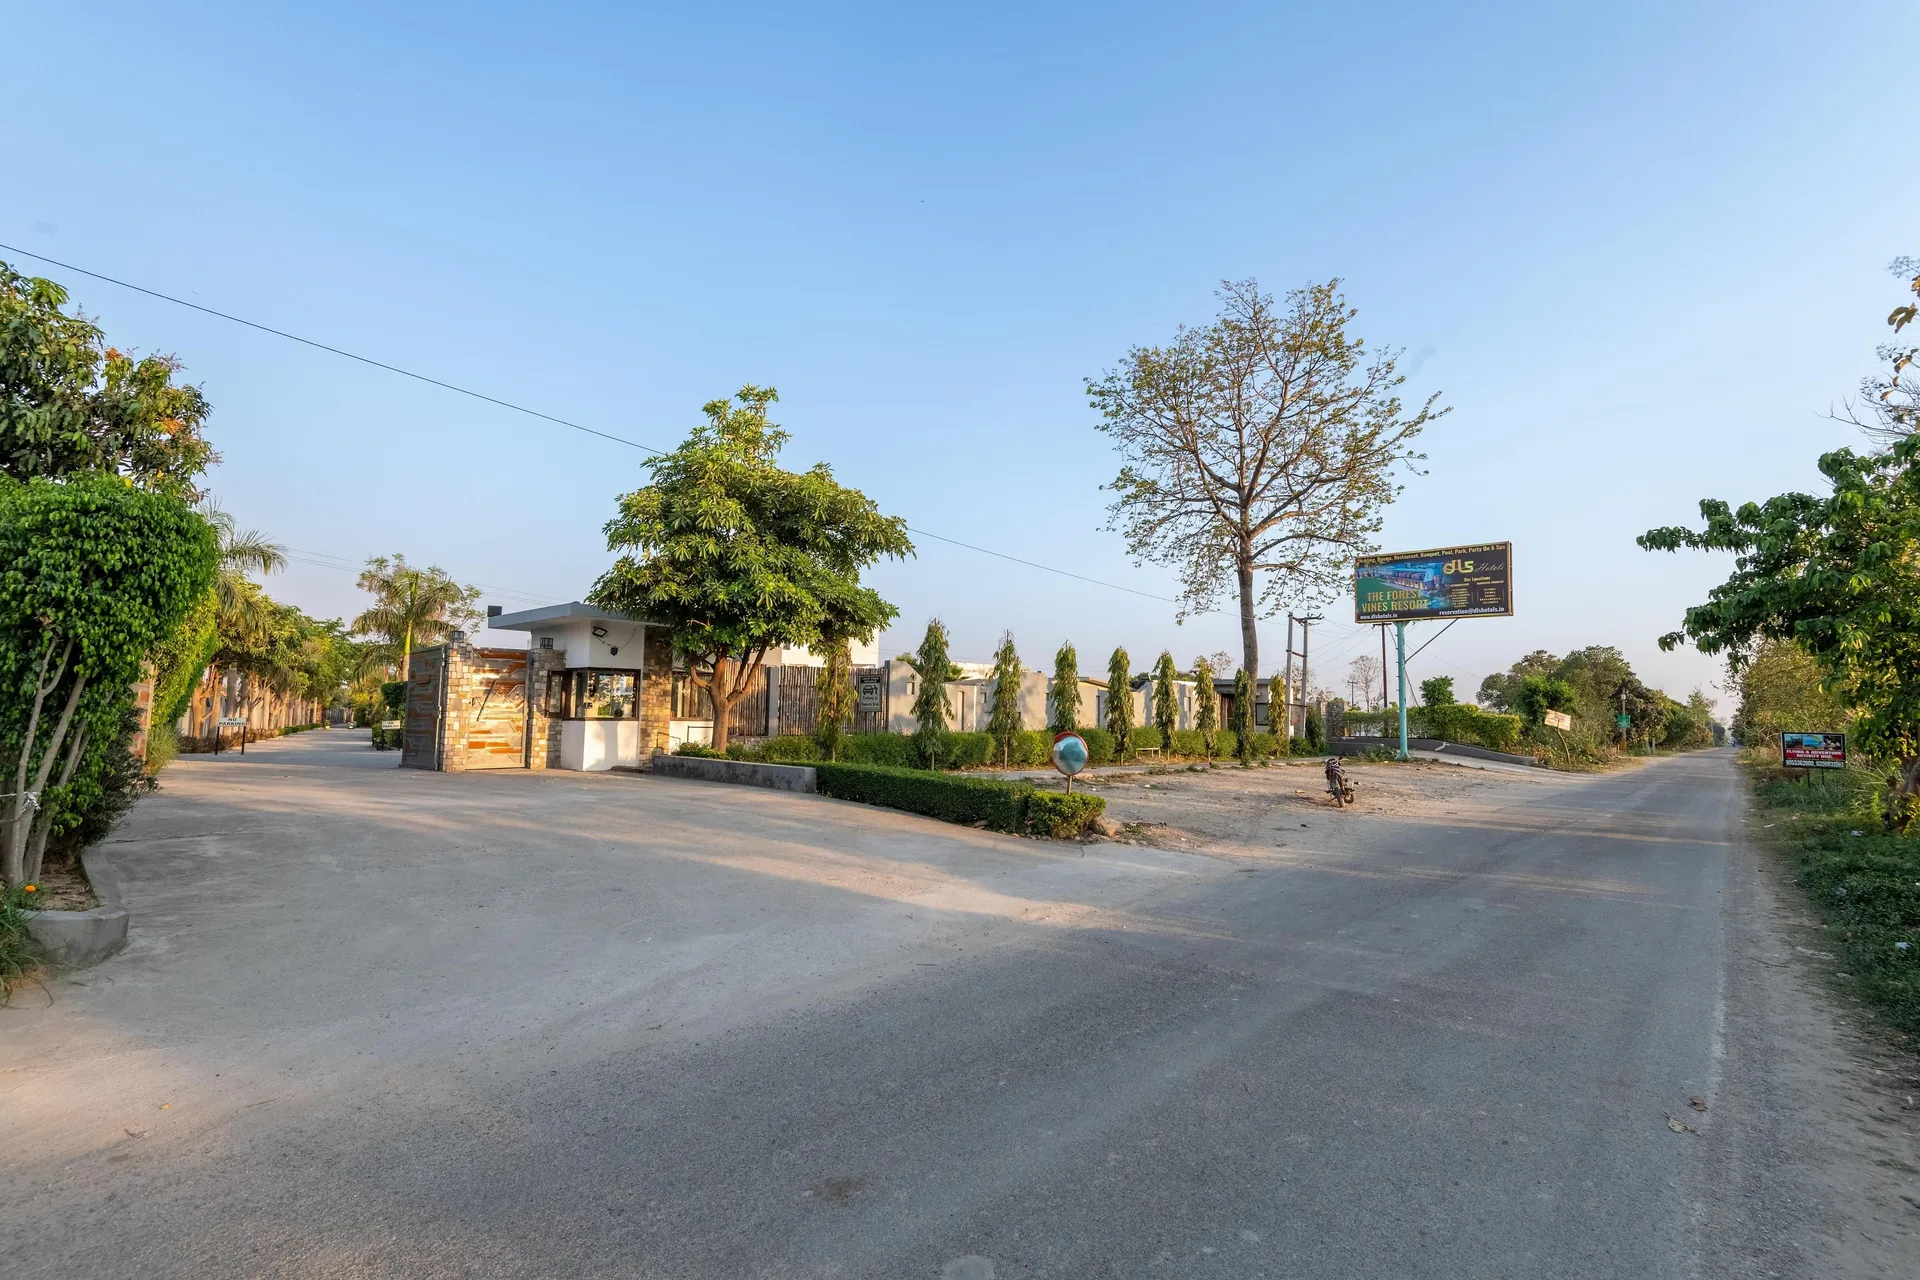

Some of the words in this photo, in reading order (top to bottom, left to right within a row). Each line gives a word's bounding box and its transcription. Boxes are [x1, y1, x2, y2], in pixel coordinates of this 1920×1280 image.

[1474, 562, 1504, 573] Hotels
[1367, 591, 1384, 602] THE
[1387, 589, 1422, 600] FOREST
[1362, 602, 1388, 613] VINES
[1391, 599, 1429, 611] RESORT
[1439, 606, 1505, 615] reservation@dlshotels.in
